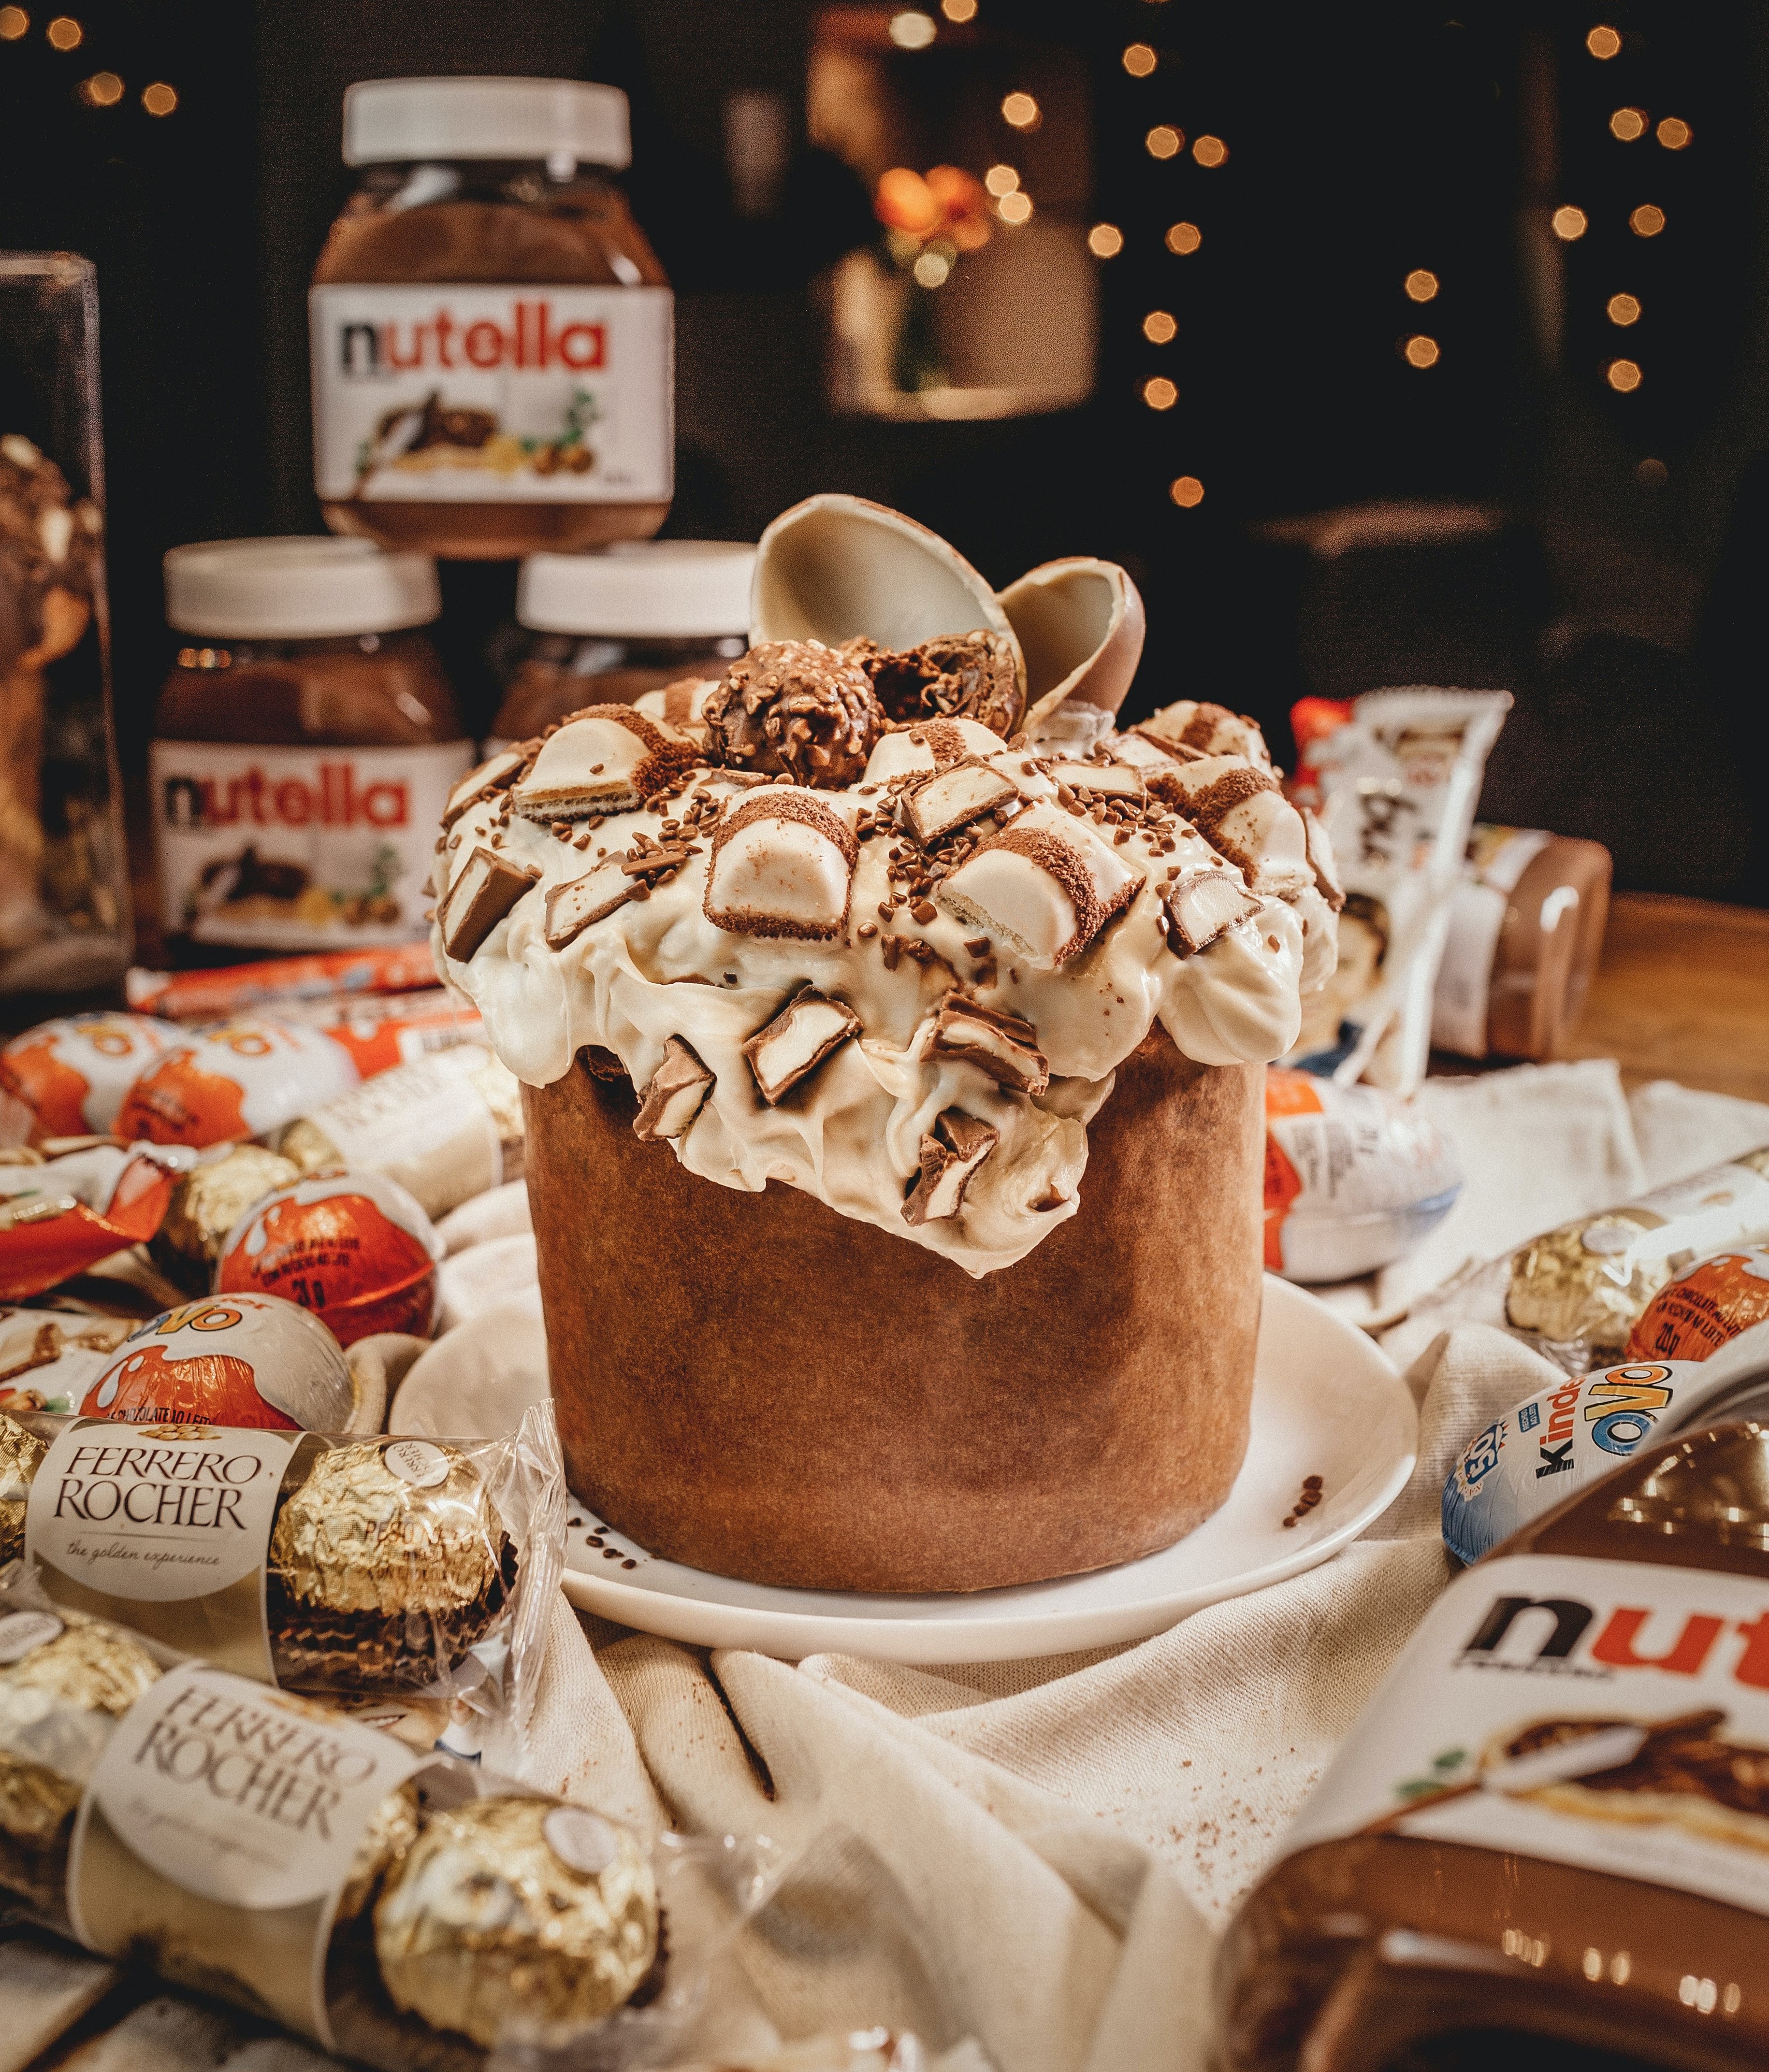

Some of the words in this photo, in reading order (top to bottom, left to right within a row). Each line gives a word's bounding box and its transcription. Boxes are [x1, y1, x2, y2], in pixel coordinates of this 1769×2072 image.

[341, 300, 607, 375] nutella
[164, 757, 409, 829] nutella
[64, 1446, 262, 1485] FERRERO
[53, 1478, 247, 1530] ROCHER
[67, 1540, 88, 1558] the
[88, 1541, 139, 1566] golden
[143, 1549, 221, 1570] experience
[134, 1719, 342, 1841] ROCHER
